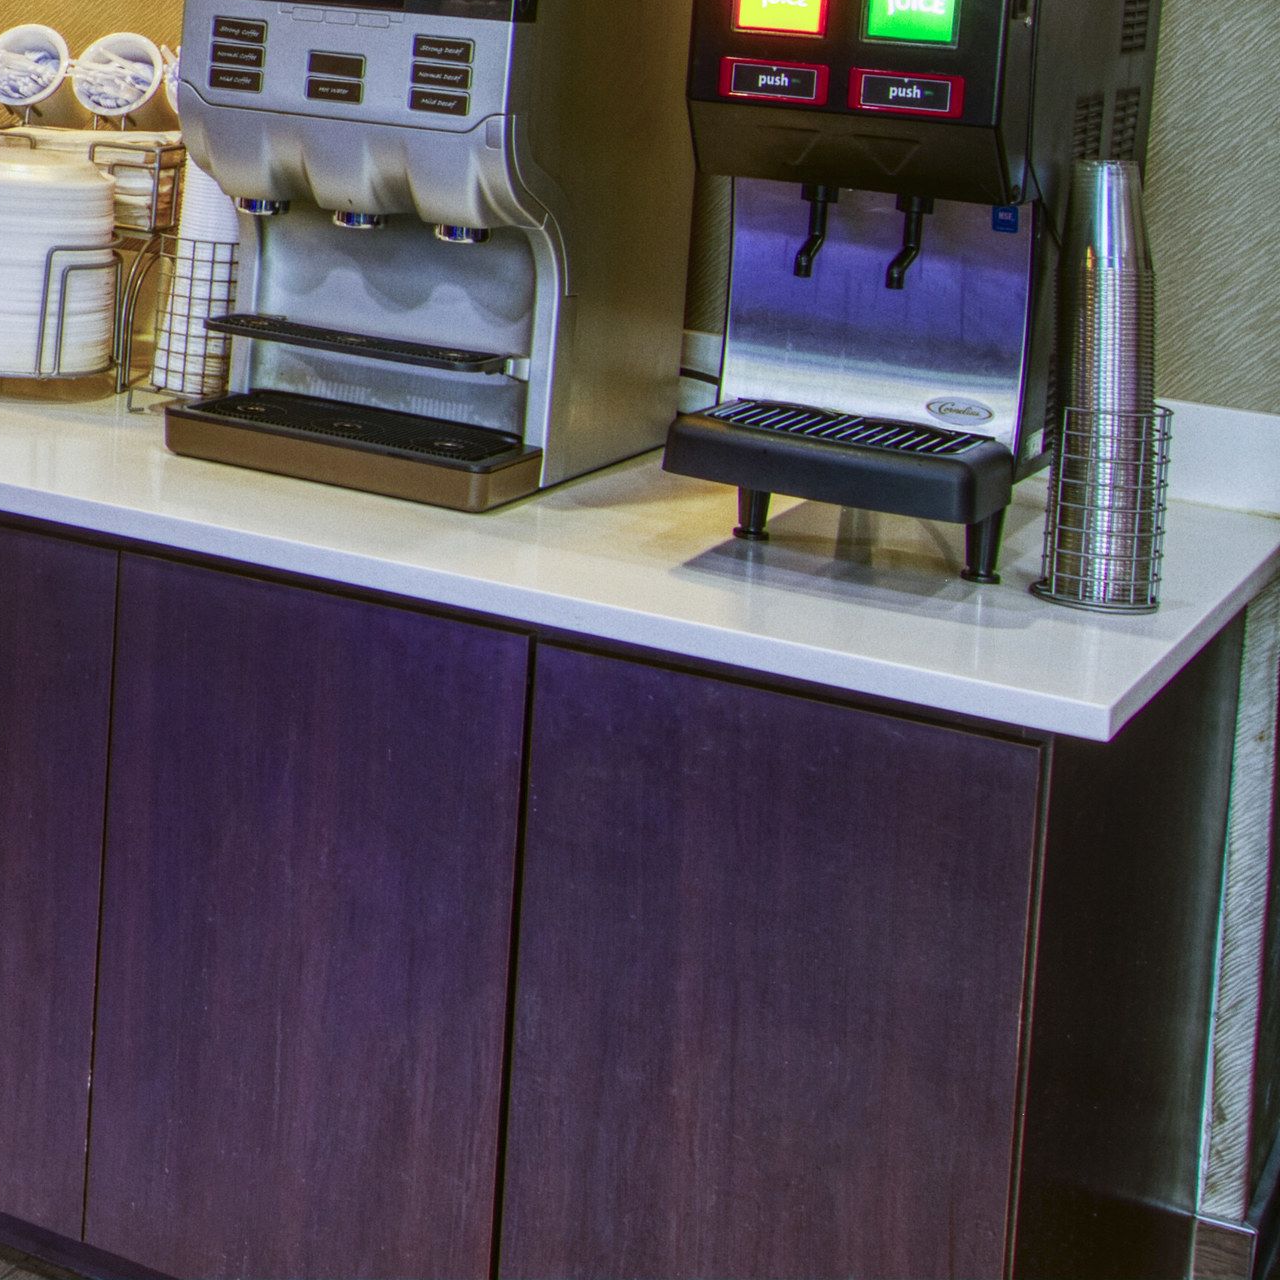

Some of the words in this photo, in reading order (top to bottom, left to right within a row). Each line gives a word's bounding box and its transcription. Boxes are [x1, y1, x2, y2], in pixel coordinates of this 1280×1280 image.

[219, 25, 240, 35] Strong
[241, 29, 260, 37] Coffee
[420, 45, 443, 55] Strong
[239, 53, 258, 61] Coffee
[758, 73, 789, 87] push
[889, 84, 921, 99] push
